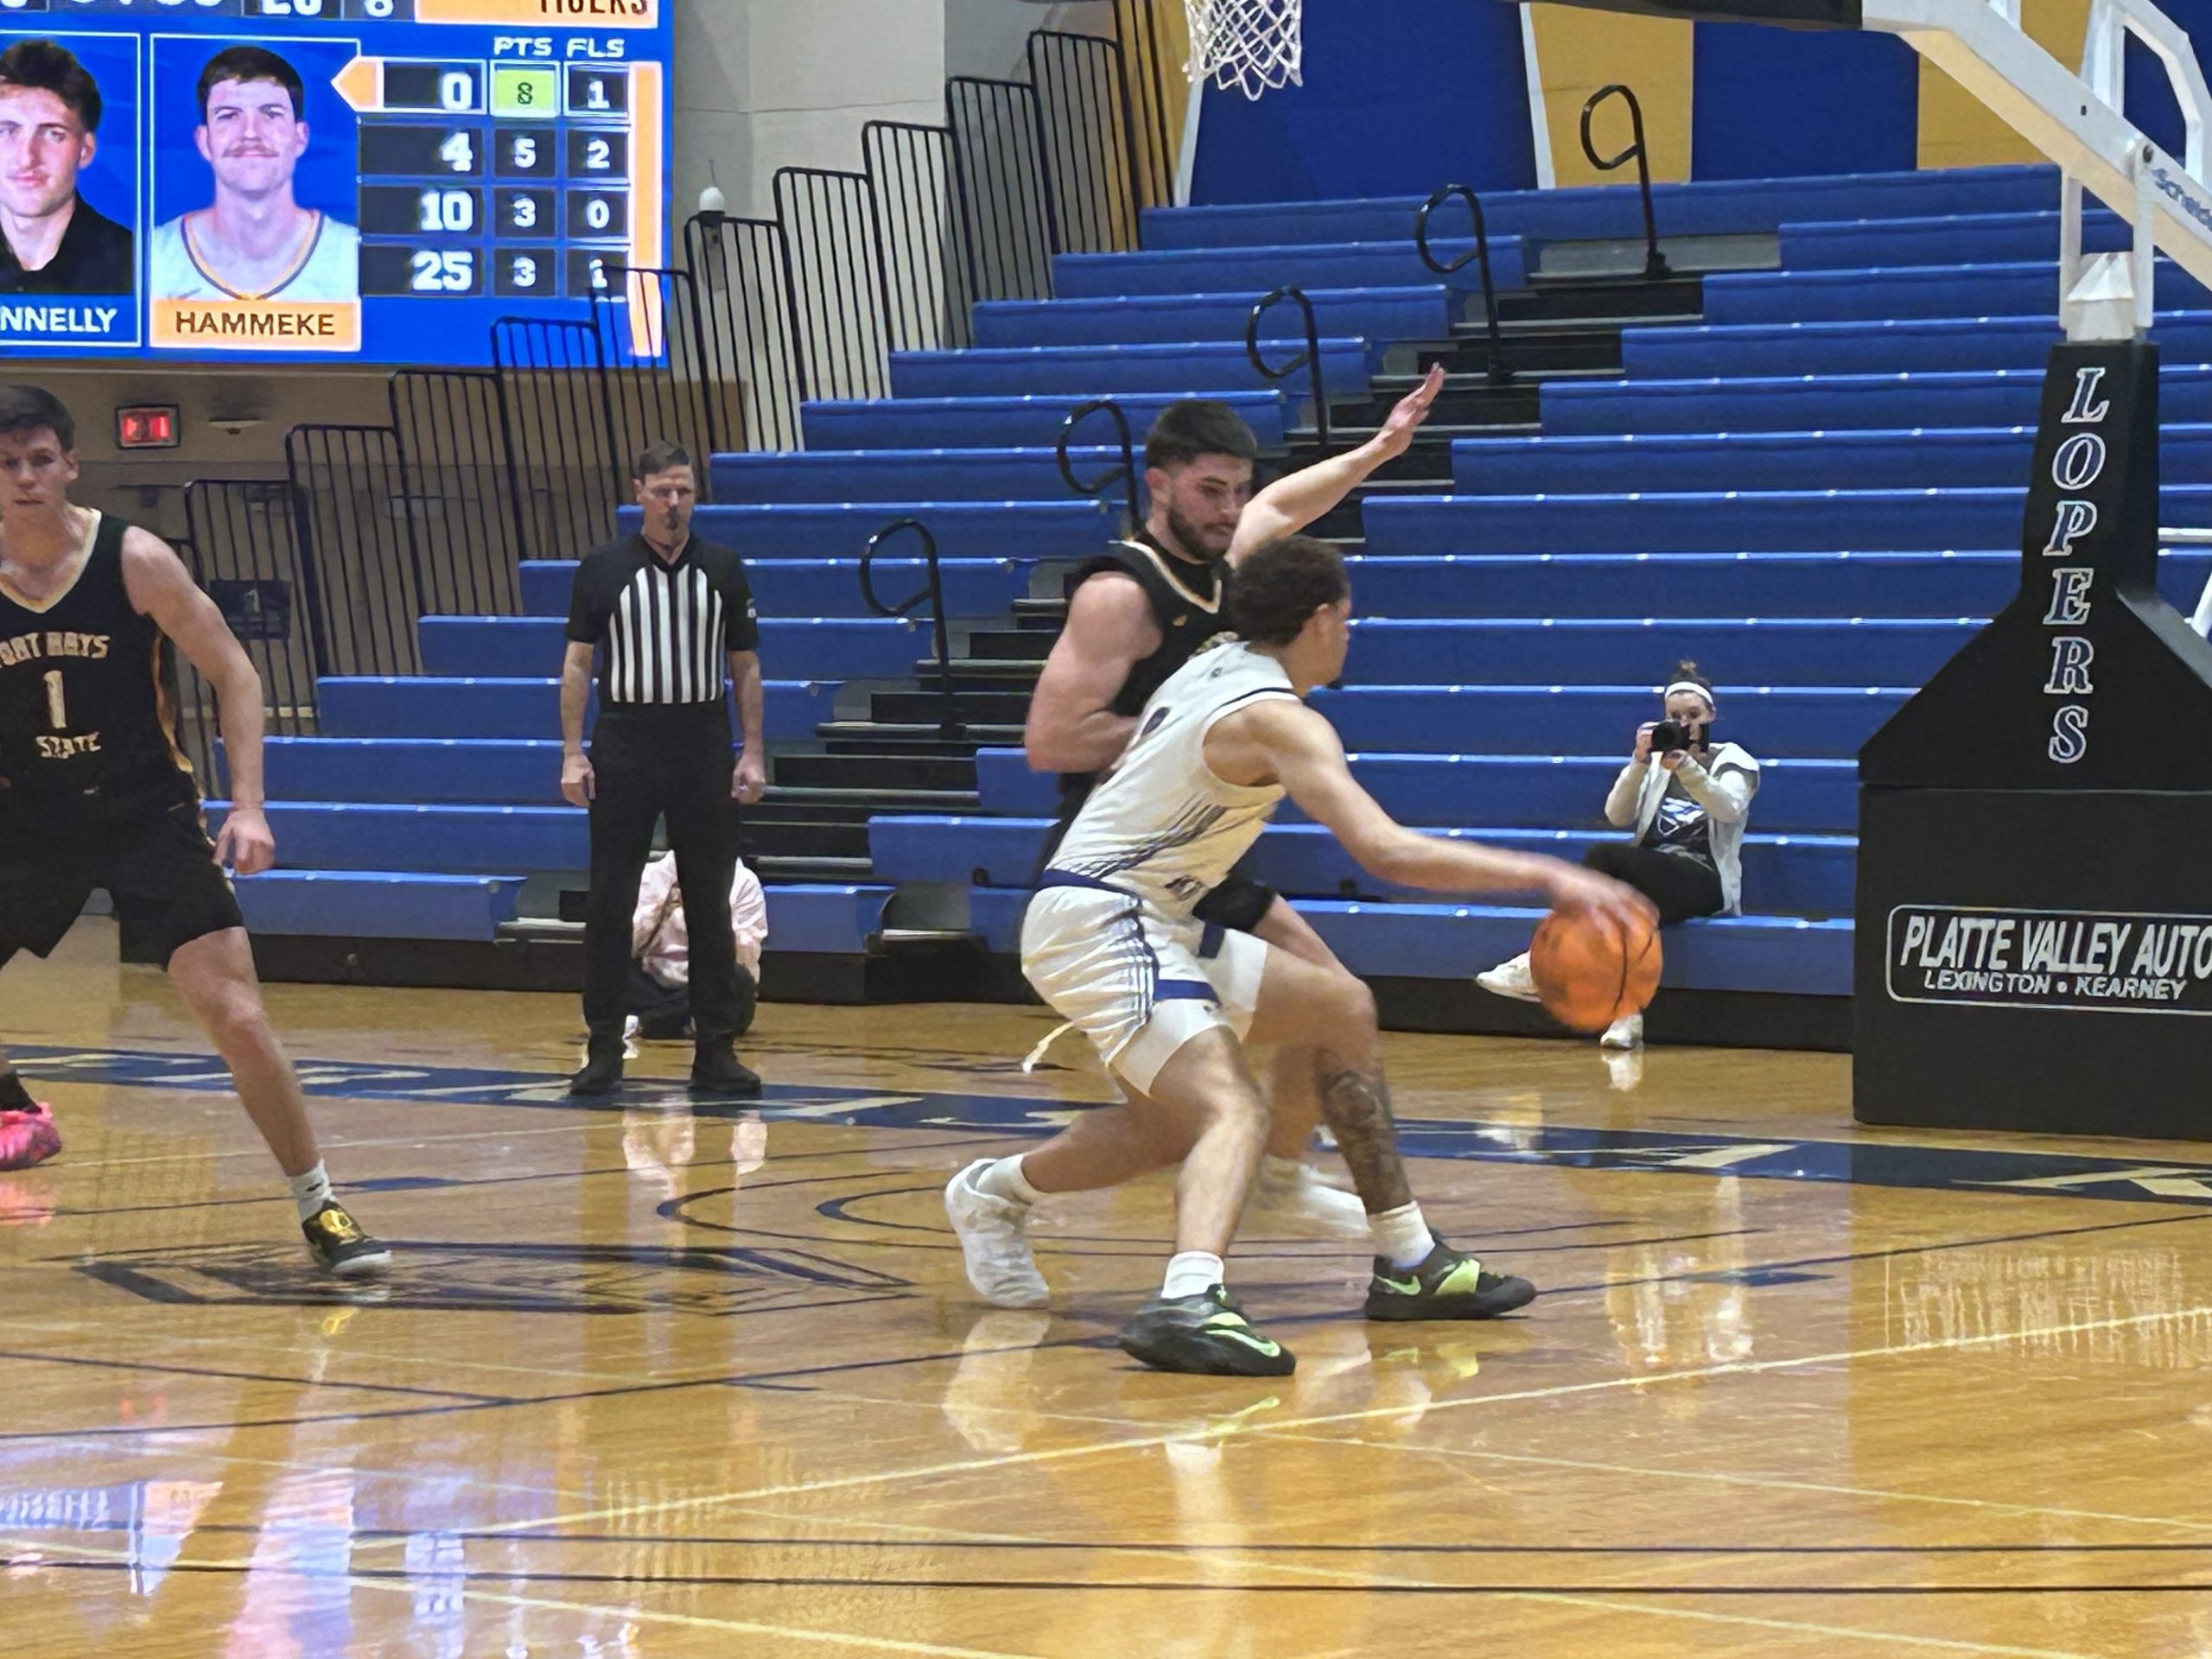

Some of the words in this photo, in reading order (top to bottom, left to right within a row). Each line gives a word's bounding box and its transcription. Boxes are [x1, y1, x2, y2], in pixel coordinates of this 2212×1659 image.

[493, 36, 553, 56] PTS
[566, 38, 625, 58] FLS
[441, 72, 474, 111] 0
[518, 82, 533, 105] 8
[587, 80, 609, 110] 1
[441, 131, 474, 172] 4
[513, 138, 537, 168] 5
[587, 140, 610, 169] 2
[421, 190, 474, 232] 10
[513, 197, 536, 227] 3
[587, 200, 610, 229] 0
[411, 251, 474, 291] 25
[512, 257, 536, 288] 3
[175, 310, 336, 336] HAMMEKE
[2043, 366, 2110, 764] LOPERS
[43, 669, 67, 729] 1
[35, 732, 102, 760] STATE
[1900, 914, 2016, 970] PLATTE
[2022, 918, 2132, 975] VALLEY
[1923, 969, 2051, 995] LEXINGTON
[2074, 976, 2189, 1001] KEARNEY
